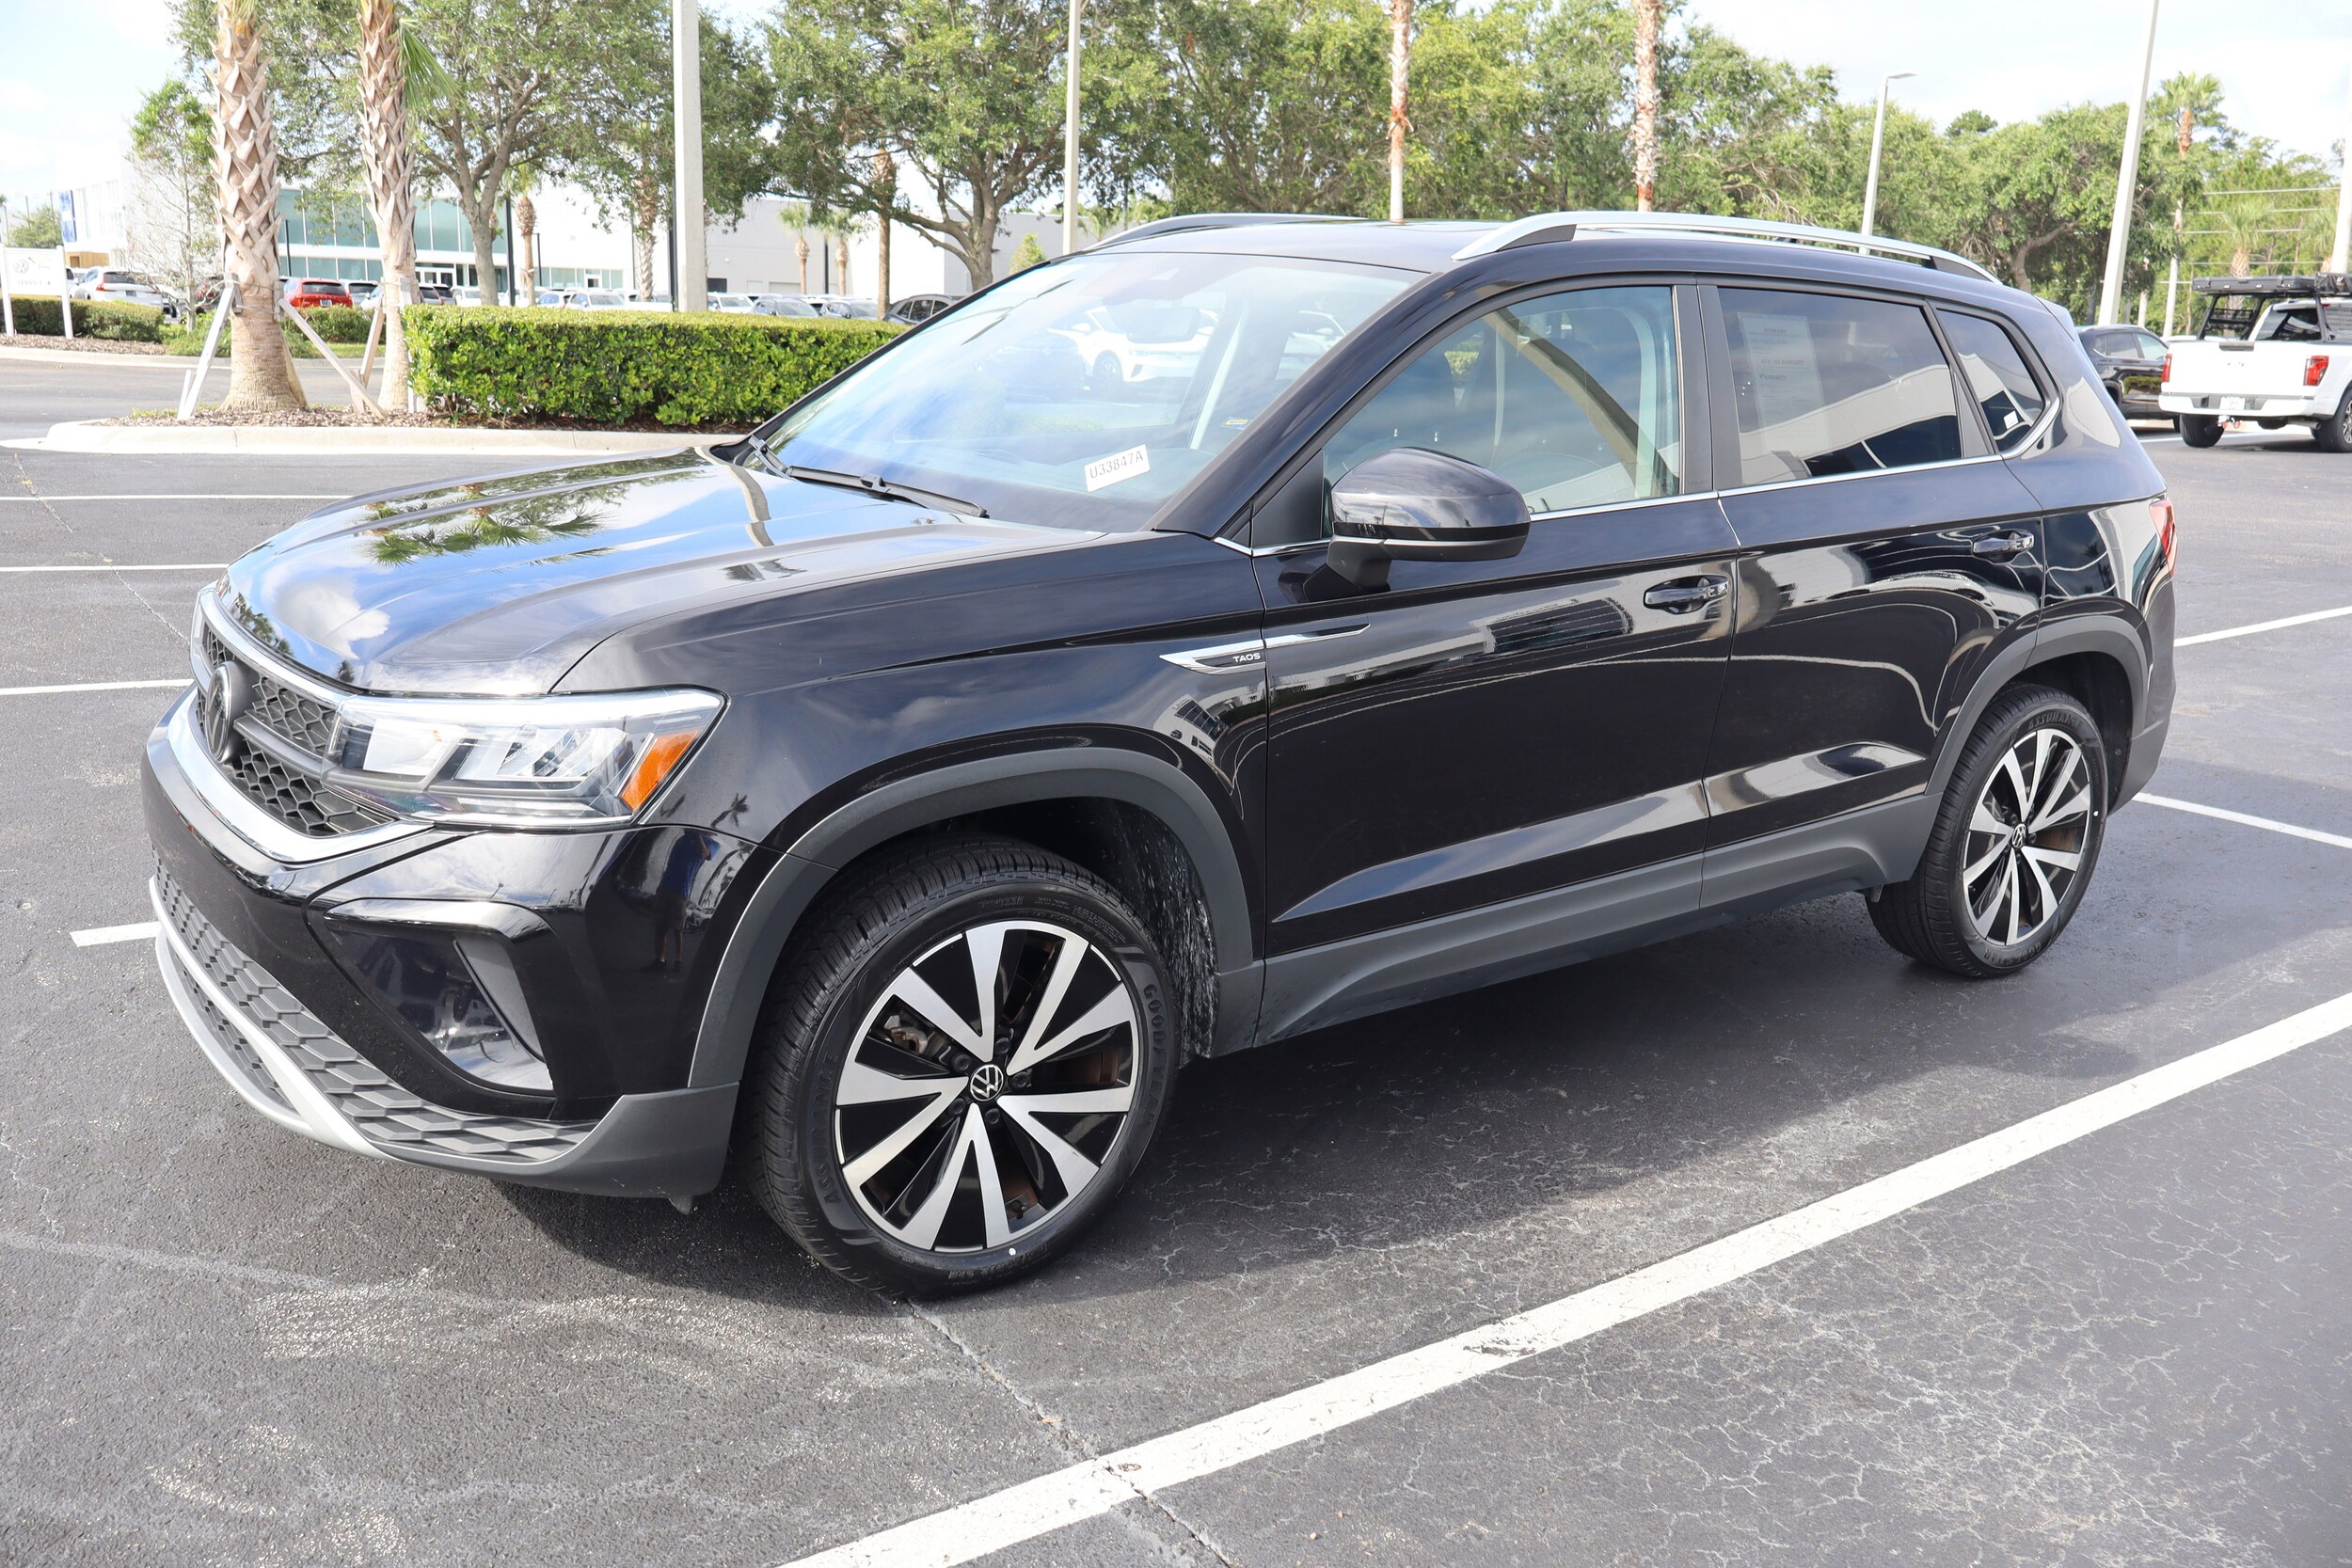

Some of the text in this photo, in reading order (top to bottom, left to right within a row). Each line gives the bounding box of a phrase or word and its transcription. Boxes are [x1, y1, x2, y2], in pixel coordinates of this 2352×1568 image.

[1089, 451, 1144, 479] U33847A
[1232, 652, 1261, 663] TAOS
[970, 1064, 1004, 1101] VW
[810, 1049, 843, 1205] ASSURANCE
